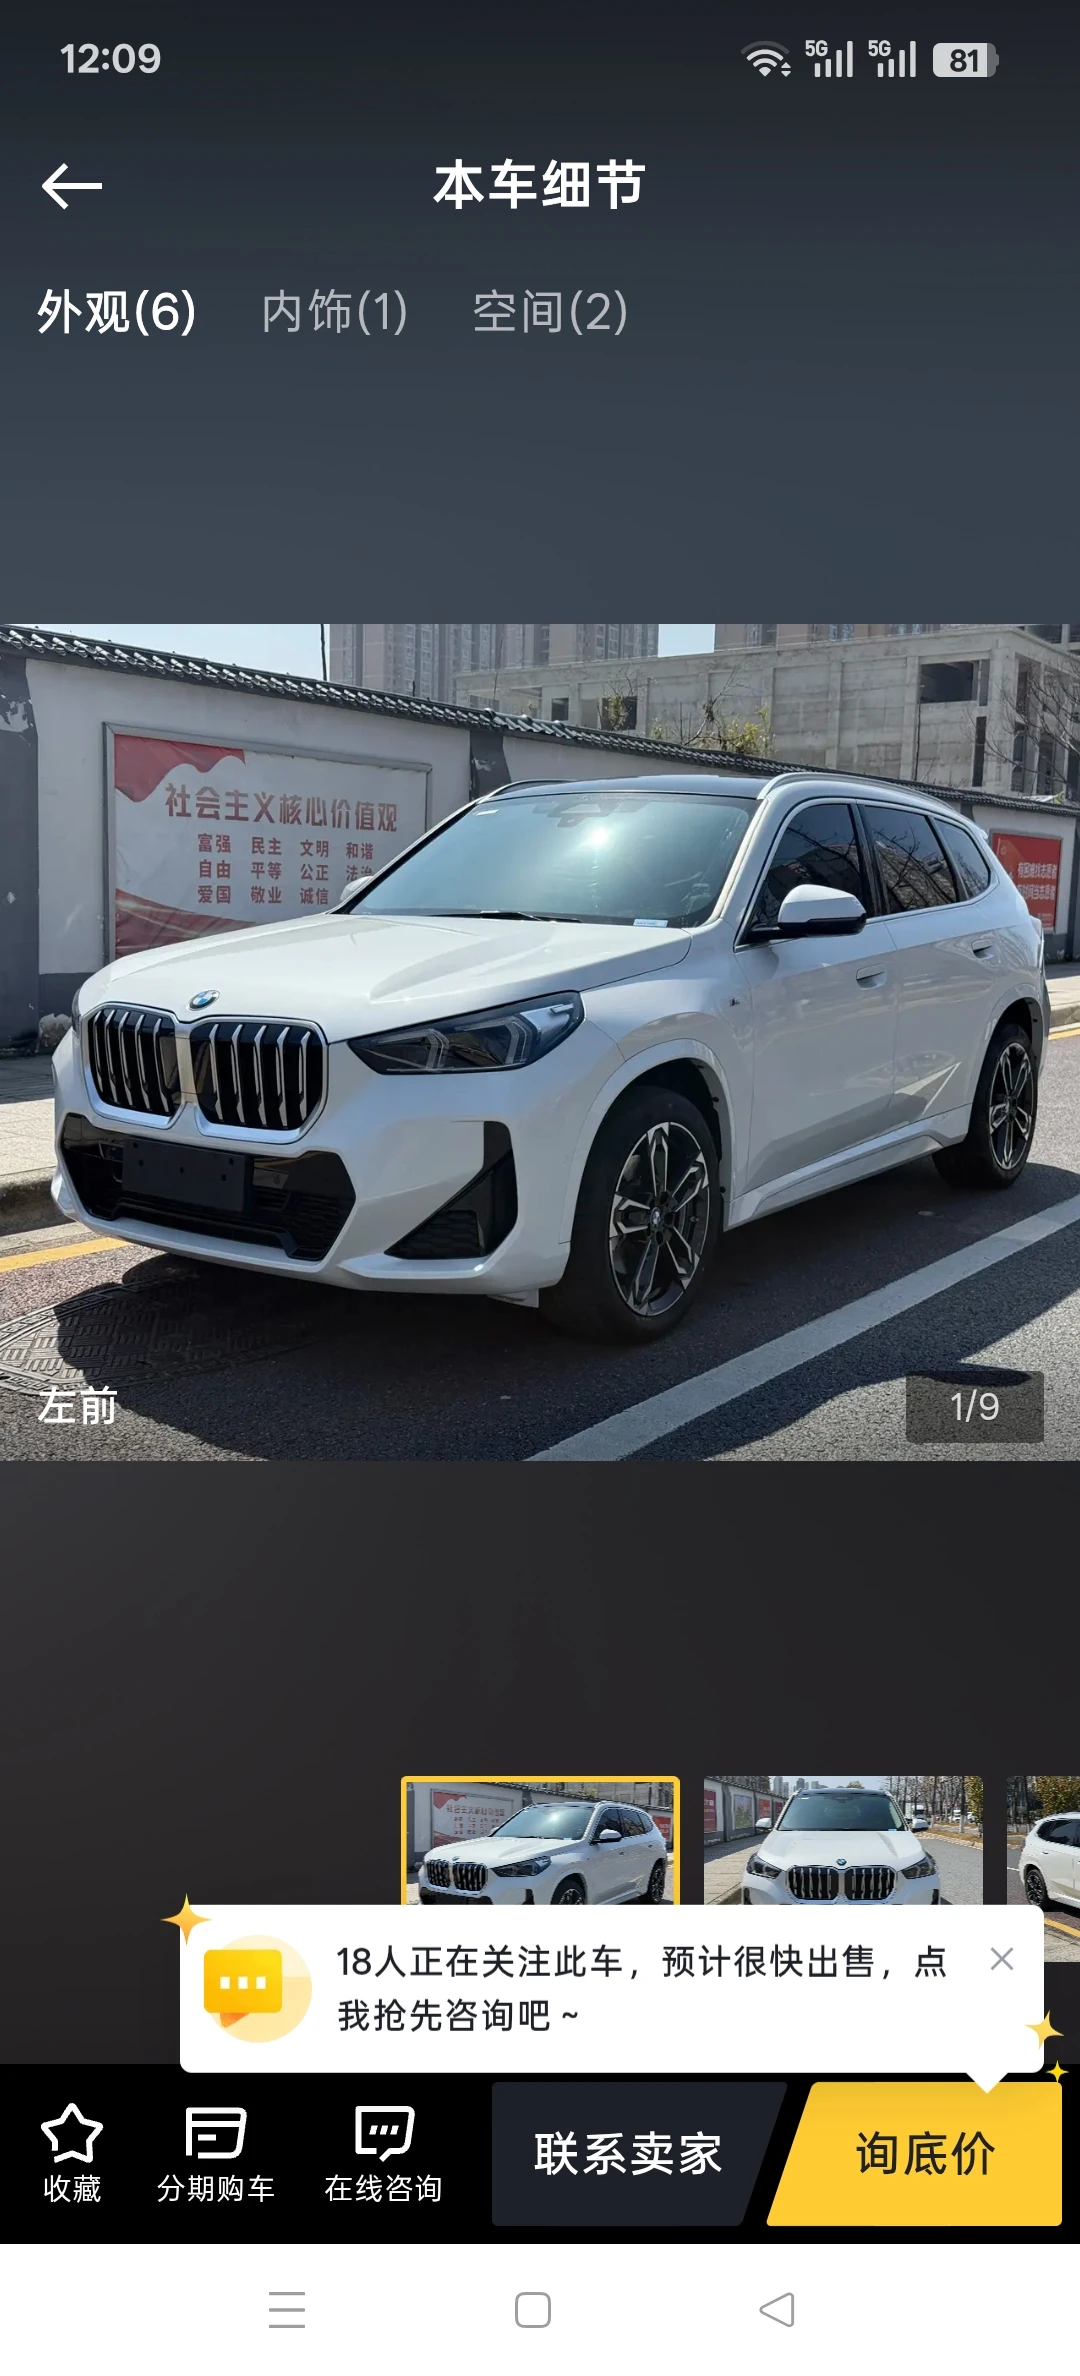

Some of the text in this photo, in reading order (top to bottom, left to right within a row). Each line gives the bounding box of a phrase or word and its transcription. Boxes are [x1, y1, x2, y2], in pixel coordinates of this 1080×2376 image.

[60, 43, 161, 74] 12:09
[805, 39, 829, 57] 5G
[867, 39, 891, 57] 5G
[949, 48, 978, 73] 81
[432, 157, 646, 210] 本车细节
[36, 288, 196, 337] 外观(6)
[262, 288, 407, 336] 内饰(1)
[472, 288, 627, 336] 空间(2)
[164, 782, 398, 832] 社会主义核心价值观
[197, 833, 374, 860] 富强 民主 文明 和谐
[198, 859, 232, 880] 自由
[250, 861, 283, 880] 平等
[300, 863, 330, 882] 公正
[197, 885, 330, 906] 爱国 敬业 诚信
[336, 1943, 947, 1980] 18人正在关注此车，预计很快出售，点
[533, 2130, 723, 2177] 联系卖家
[856, 2130, 996, 2177] 询底价
[43, 2173, 102, 2204] 收藏
[156, 2173, 275, 2204] 分期购车
[324, 2173, 442, 2204] 在线咨询
